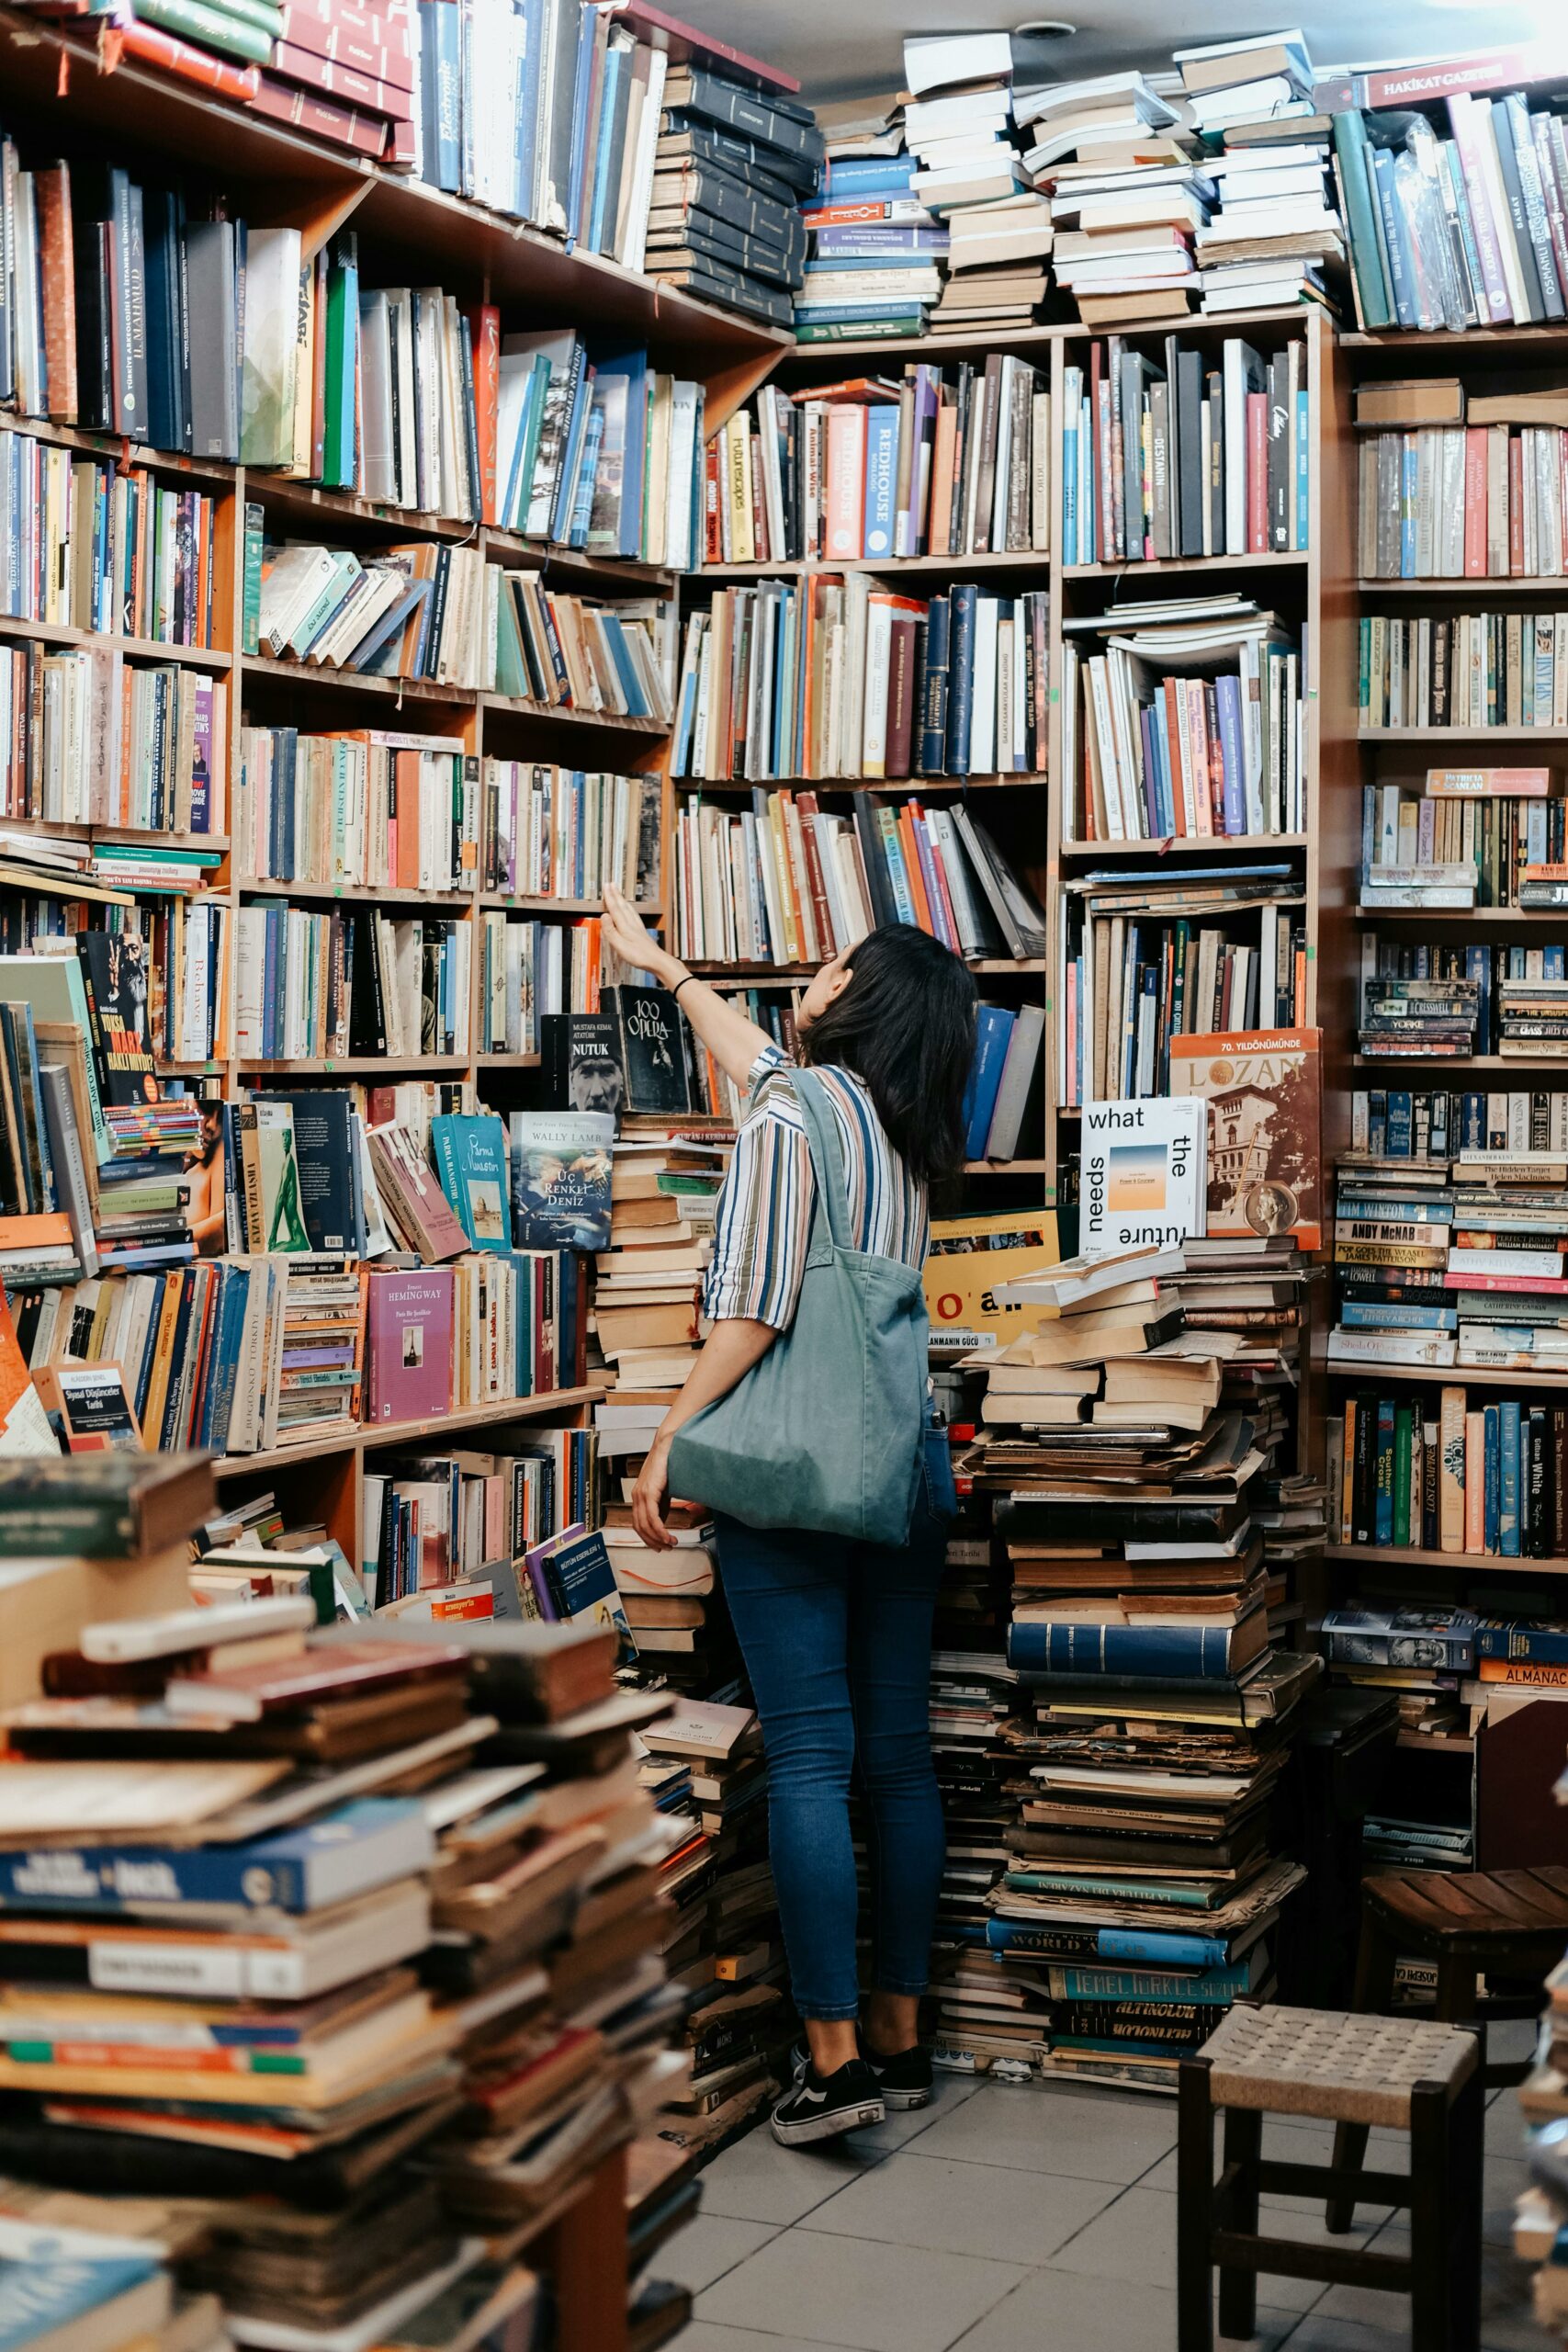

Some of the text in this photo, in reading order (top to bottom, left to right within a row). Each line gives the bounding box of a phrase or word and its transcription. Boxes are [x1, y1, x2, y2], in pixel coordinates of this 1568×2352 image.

[1512, 196, 1522, 230] DAMAT
[1539, 248, 1554, 295] OSMANLI
[131, 268, 142, 344] MAHMUD
[561, 343, 582, 438] INDIAN GYPSIES
[1155, 437, 1165, 487] DESTANIN
[733, 437, 744, 511] Futurescapes
[840, 427, 854, 521] REDHOUSE
[877, 428, 891, 523] REDHOUSE
[1536, 656, 1552, 701] SPLASH
[1443, 782, 1483, 791] SCANLAN
[1445, 774, 1483, 783] PATRICIA
[193, 959, 205, 1024] Behave
[634, 999, 660, 1020] 100
[1415, 1002, 1450, 1015] CRESSWELL
[100, 1014, 126, 1033] YOKSA
[572, 1023, 596, 1032] MUSTAFA
[626, 1015, 674, 1041] OPERA
[1391, 1020, 1424, 1029] YORKE
[110, 1031, 143, 1055] MARX
[572, 1031, 596, 1040] ATATÜRK
[571, 1043, 609, 1057] NUTUK
[1221, 1038, 1302, 1052] 70. YILDÖNÜMÜNDE
[107, 1052, 130, 1071] HAKLI
[1188, 1057, 1303, 1088] LOZAN
[83, 1036, 103, 1141] PSİKOLOJİYE GİRİŞ
[1088, 1106, 1145, 1130] what
[468, 1134, 495, 1160] Parma
[532, 1132, 603, 1144] WALLY LAMB
[1171, 1135, 1192, 1178] the
[557, 1170, 576, 1185] ÜÇ
[1483, 1166, 1551, 1175] The Hidden Target
[1491, 1173, 1551, 1182] Helen MacInnes
[446, 1160, 459, 1201] MANASTIRI
[544, 1182, 588, 1195] RENKLİ
[547, 1194, 585, 1207] DENİZ
[1086, 1156, 1105, 1233] needs
[1339, 1204, 1406, 1219] TIM WINTON
[252, 1211, 262, 1246] KAZAN
[1351, 1223, 1416, 1241] ANDY McNAB
[1495, 1235, 1528, 1243] PERFECT
[1495, 1241, 1555, 1250] WILLIAM BERNHARDT
[1345, 1252, 1417, 1264] JAMES PATTERSON
[1358, 1246, 1376, 1254] GOES
[1377, 1247, 1393, 1255] THE
[1394, 1248, 1425, 1258] WEASEL
[1349, 1272, 1377, 1283] LOWELL
[388, 1288, 442, 1303] HEMINGWAY
[406, 1283, 423, 1291] Ernest
[1402, 1289, 1448, 1303] PROGRAM
[395, 1309, 406, 1318] Paris
[1391, 1315, 1425, 1324] ARCHER
[962, 1335, 979, 1346] GÜCÜ
[64, 1386, 120, 1400] Siyasal Düşünceler
[85, 1398, 104, 1411] Tarihi
[1443, 1402, 1454, 1474] TRADITION
[1452, 1402, 1463, 1471] AMERICAN
[1385, 1447, 1393, 1498] Southern
[1426, 1443, 1437, 1513] LOST EMPIRES
[1531, 1462, 1544, 1496] White
[516, 1471, 525, 1513] BABALARDAN
[1554, 1487, 1562, 1509] Bond
[559, 1545, 596, 1572] BÜTÜN ESERLERİ
[960, 1549, 981, 1558] Tarihi
[1506, 1668, 1568, 1685] ALMANAC
[1064, 1804, 1103, 1814] Colourful
[1128, 1811, 1164, 1820] Country
[1038, 1881, 1171, 1903] LA PITTURA DEI NAZARENI
[1010, 1934, 1081, 1950] WORLD
[1075, 1970, 1129, 1995] TEMEL
[1133, 1972, 1198, 1996] TÜRKÇE
[1406, 1969, 1438, 1984] JOSEPH
[1114, 2001, 1197, 2020] ALTINOLUK
[1112, 2022, 1192, 2040] ALTINOLUK
